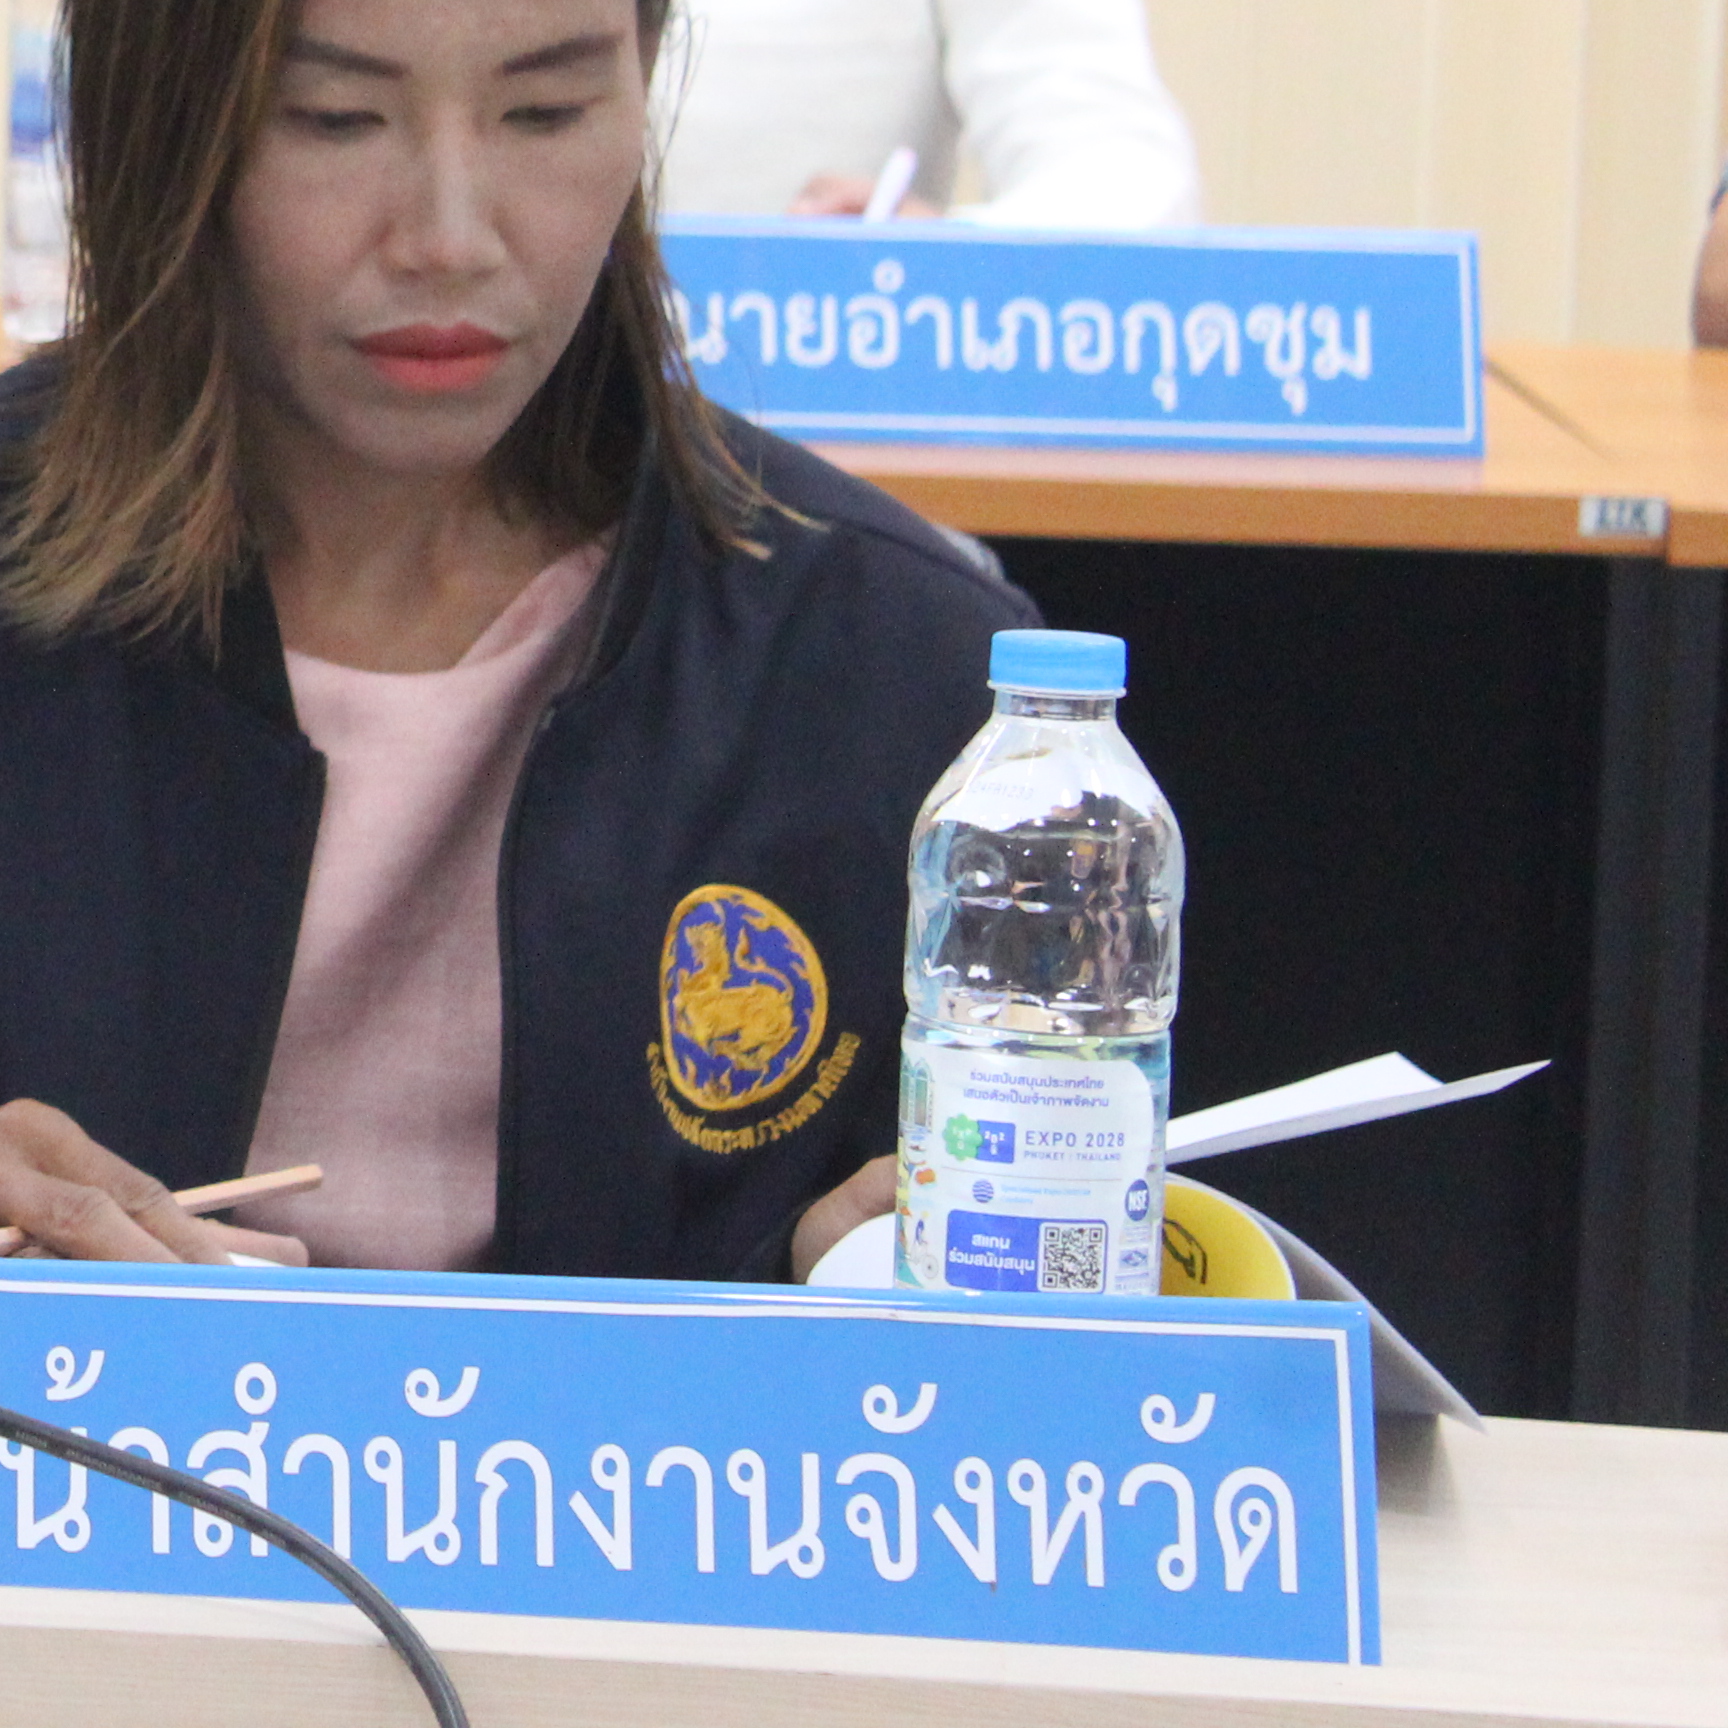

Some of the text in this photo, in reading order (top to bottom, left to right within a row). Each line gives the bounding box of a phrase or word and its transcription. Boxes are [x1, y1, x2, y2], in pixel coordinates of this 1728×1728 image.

[658, 257, 1374, 414] นายอำเภอกุดชุม
[1025, 1130, 1126, 1148] EXPO 2028
[971, 1233, 1011, 1250] สแกน
[948, 1246, 1036, 1276] ร่วมสนับสนุน
